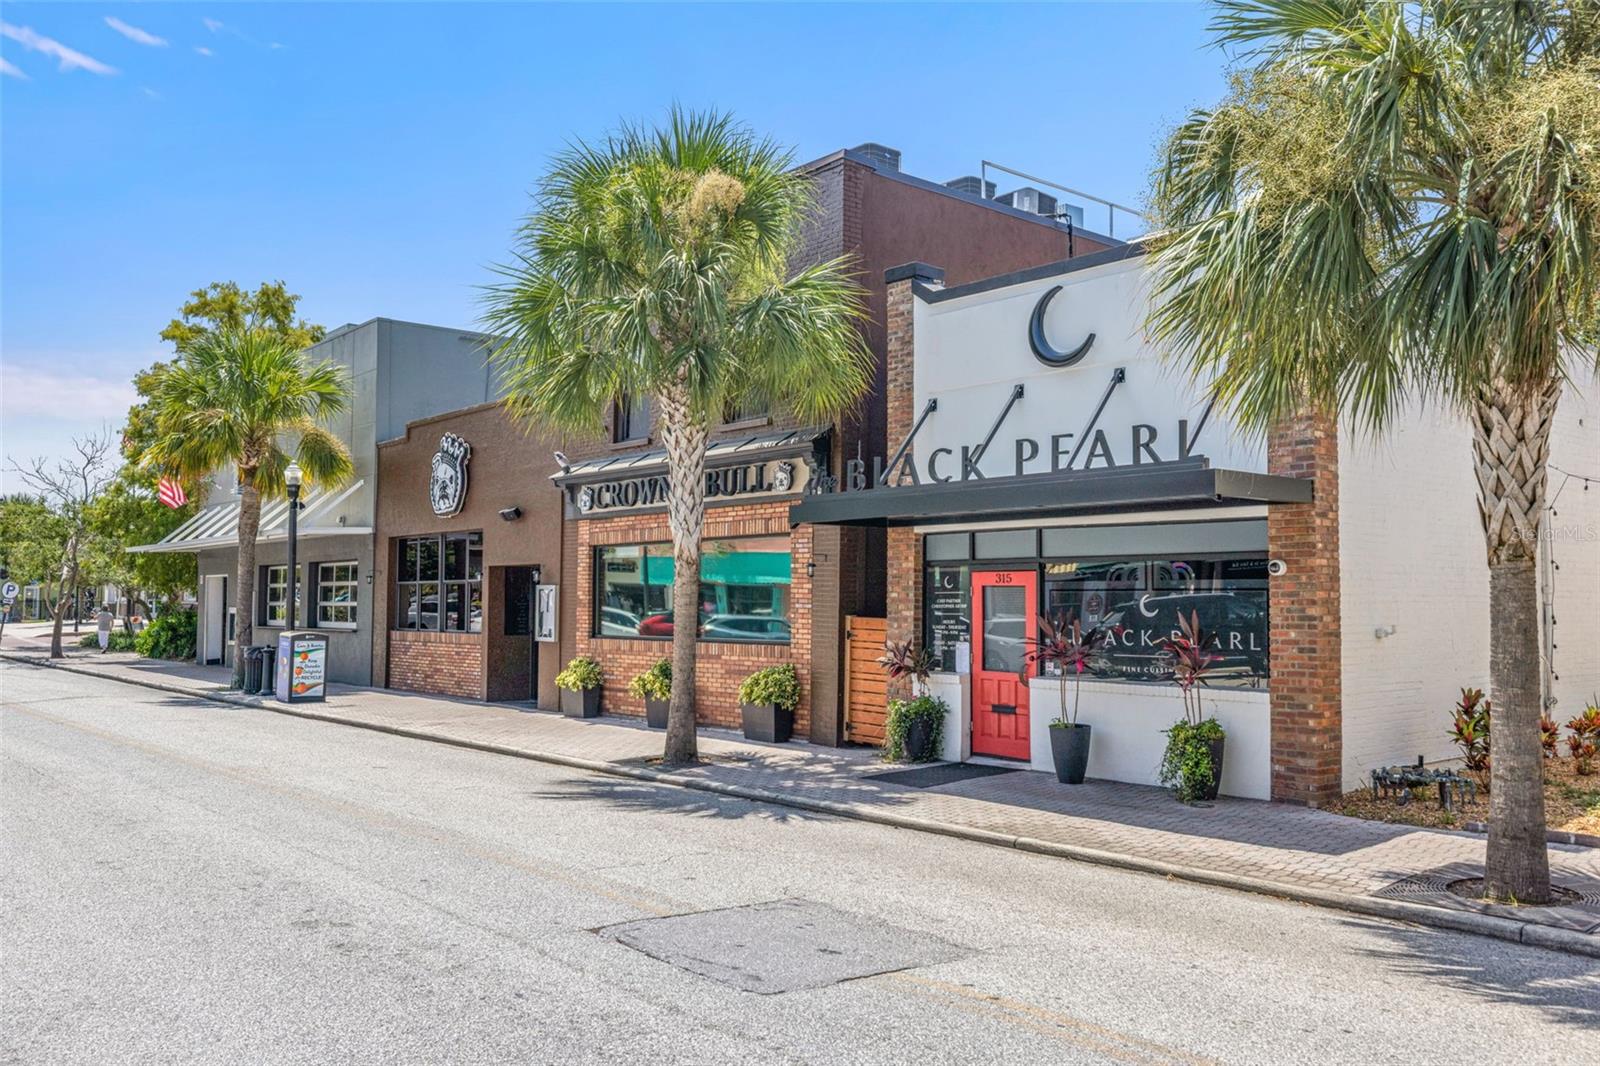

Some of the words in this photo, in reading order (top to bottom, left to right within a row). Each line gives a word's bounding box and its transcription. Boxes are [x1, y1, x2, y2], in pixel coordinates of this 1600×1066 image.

[846, 444, 987, 492] BLACK
[1015, 419, 1204, 476] PEARL
[703, 463, 774, 498] BULL
[6, 584, 16, 595] P
[995, 573, 1012, 584] 315
